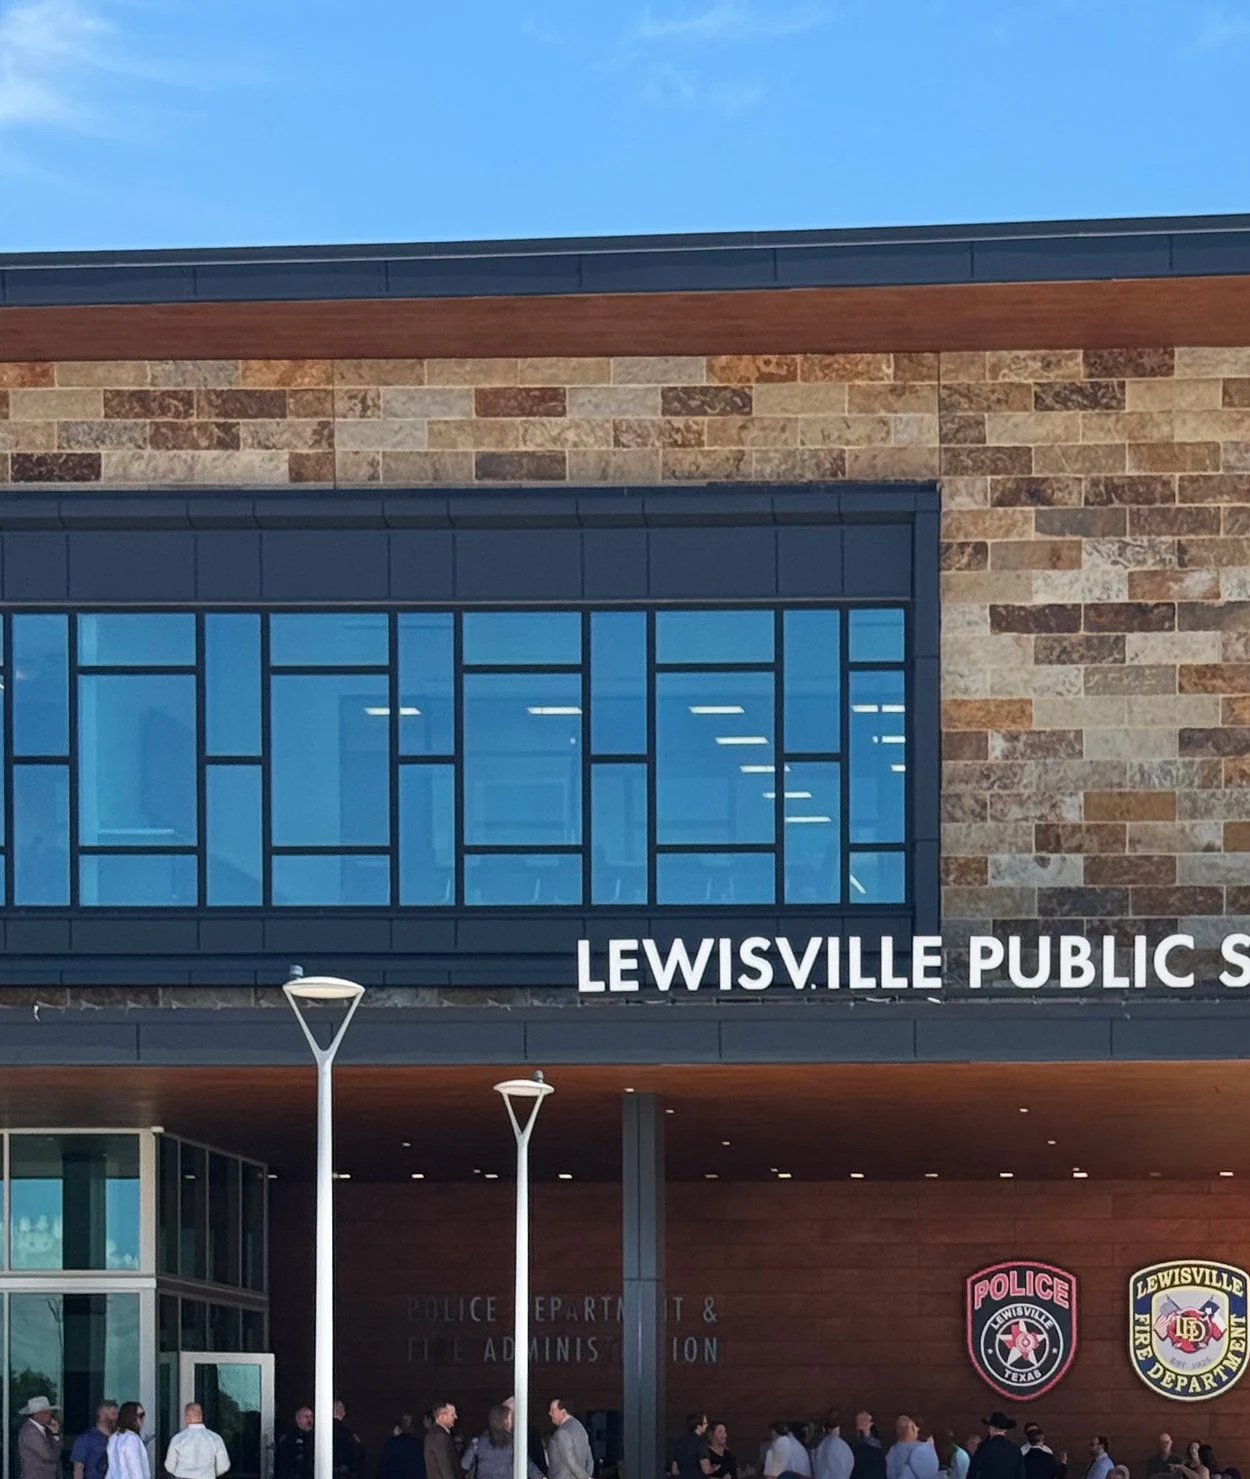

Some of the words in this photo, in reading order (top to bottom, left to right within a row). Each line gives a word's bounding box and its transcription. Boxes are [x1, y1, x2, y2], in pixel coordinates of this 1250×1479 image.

[577, 933, 943, 993] LEWISVILLE
[968, 932, 1196, 989] PUBLIC
[973, 1269, 1070, 1311] POLICE
[1136, 1266, 1245, 1300] LEWISVILLE
[407, 1295, 497, 1323] POLICE
[702, 1296, 719, 1323] &
[990, 1305, 1055, 1331] LEWISVILLE
[407, 1336, 464, 1363] FIE
[1134, 1312, 1152, 1361] FIRE
[1147, 1313, 1246, 1394] DEPARTMENT
[1004, 1368, 1042, 1383] TEXAS
